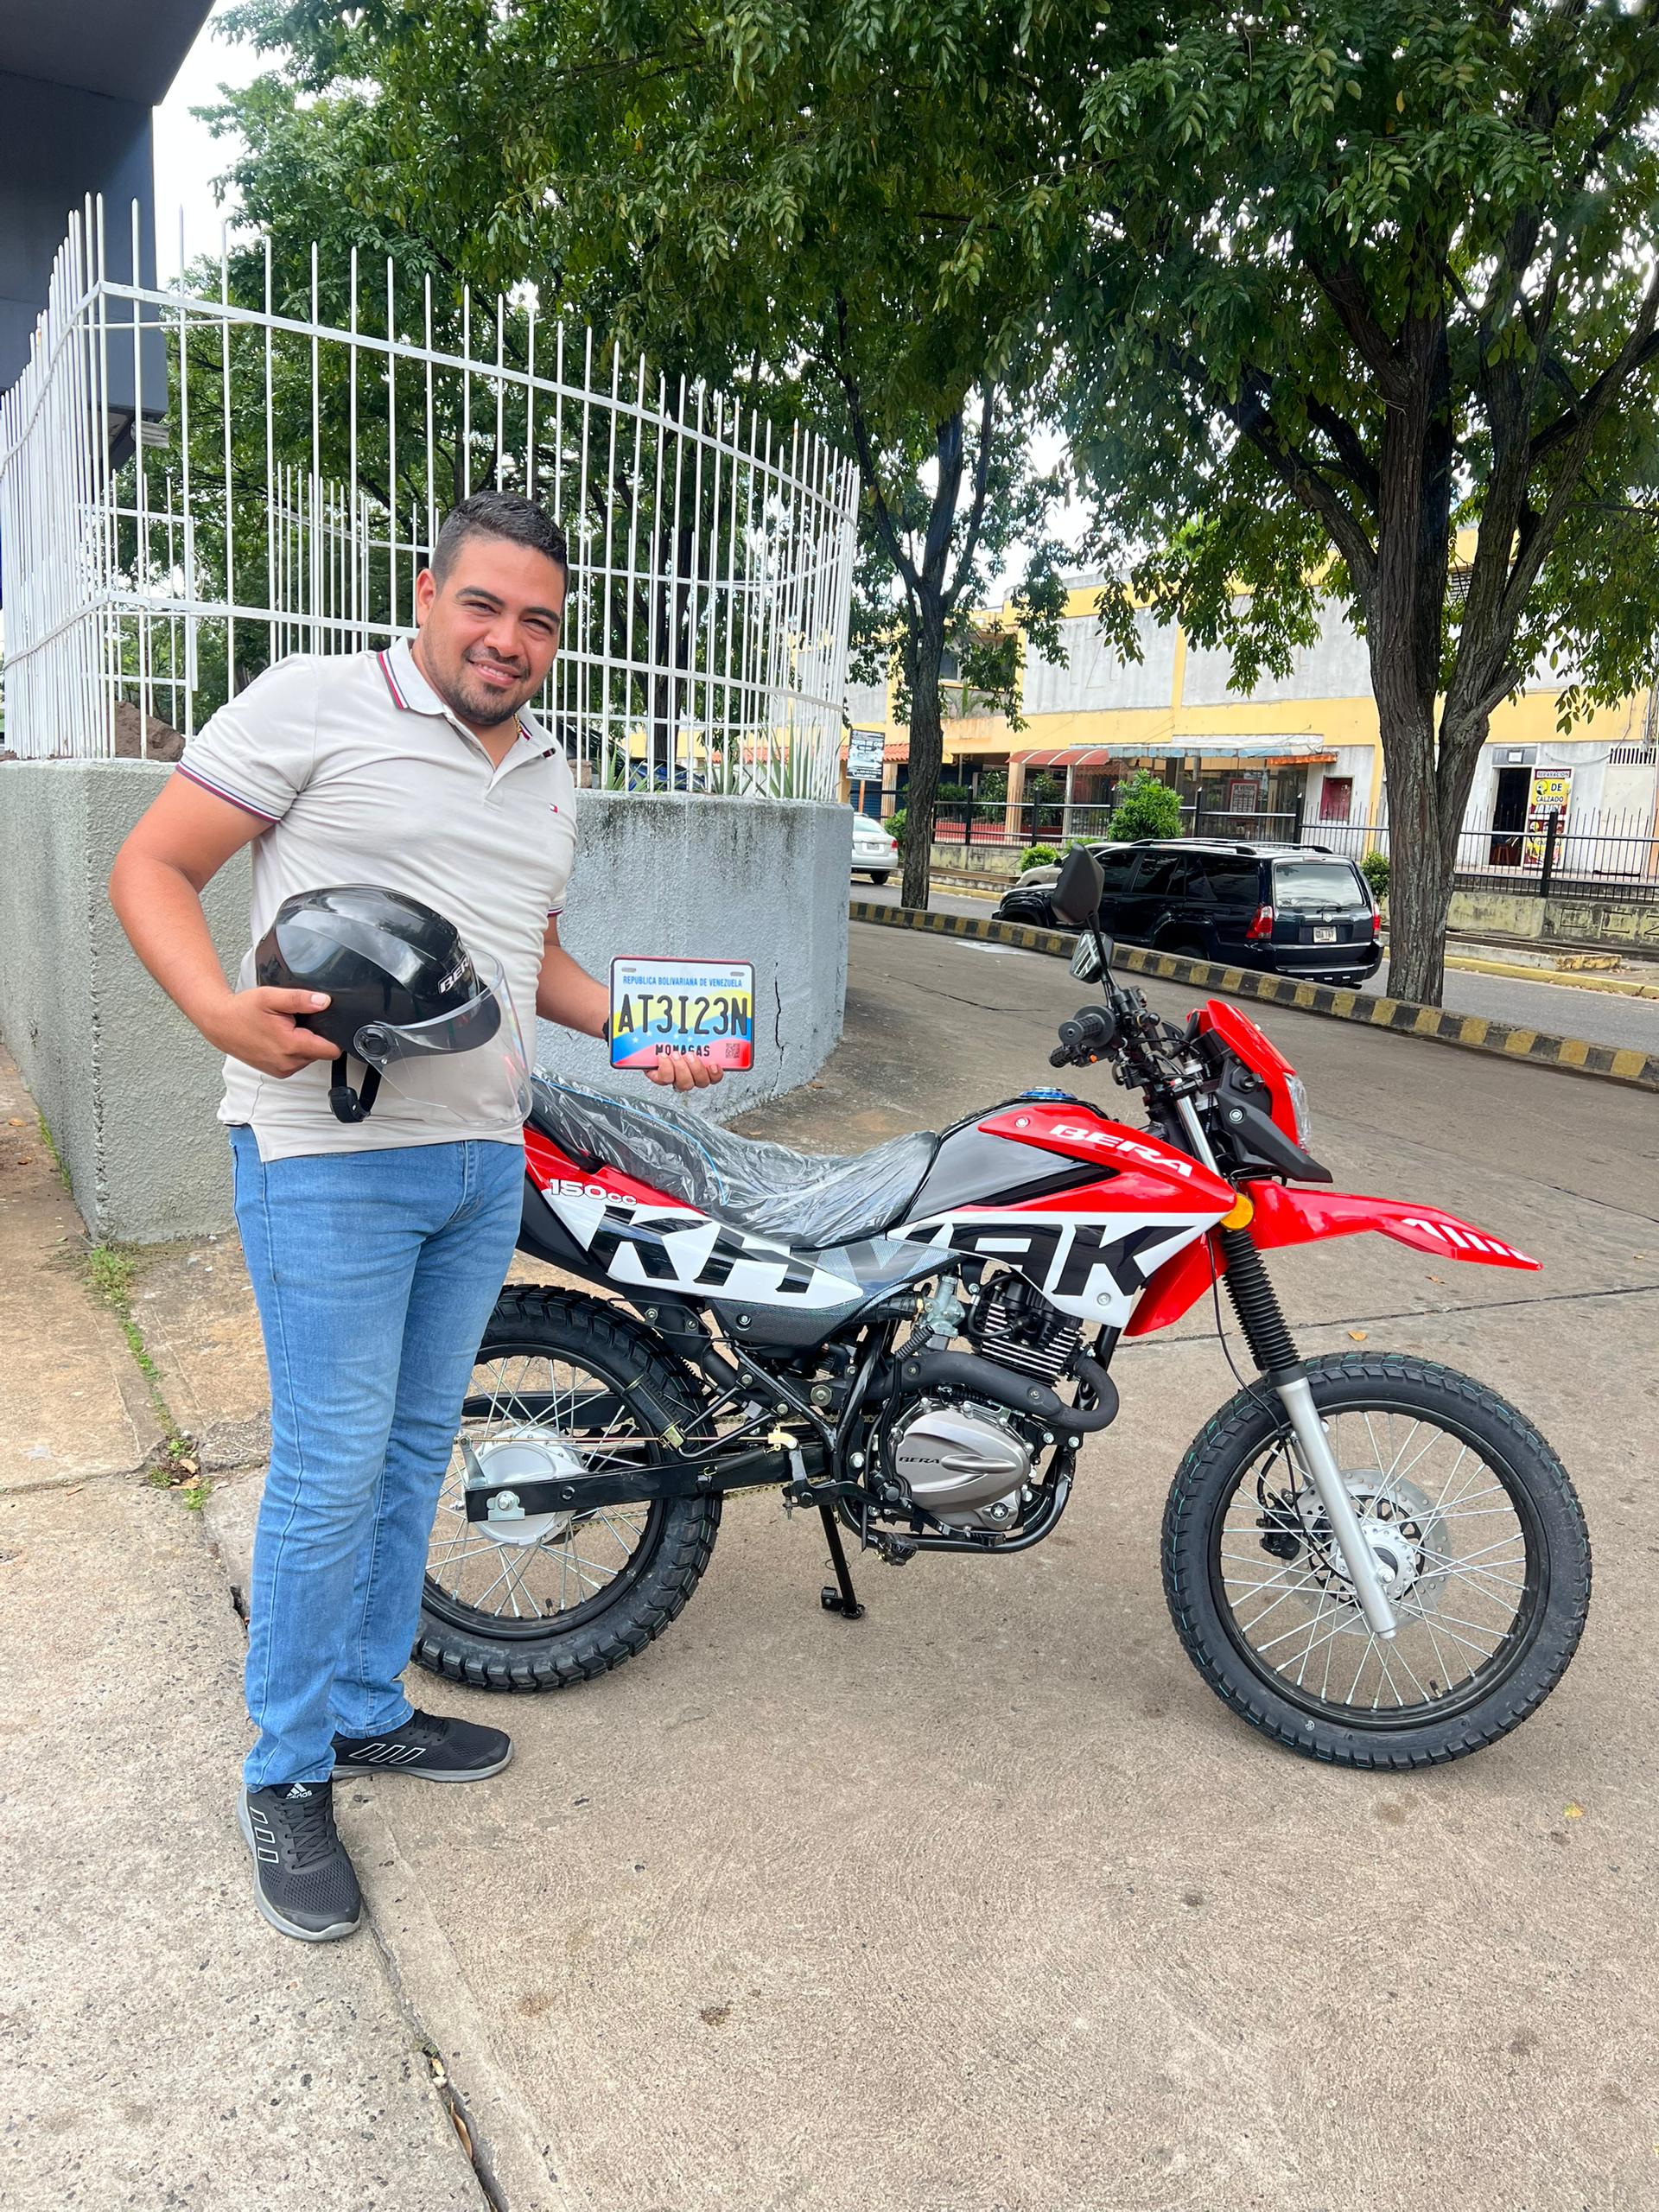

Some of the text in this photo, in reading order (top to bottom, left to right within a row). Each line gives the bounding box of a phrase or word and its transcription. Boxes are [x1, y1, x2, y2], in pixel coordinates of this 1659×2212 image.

[1551, 783, 1562, 791] DE
[440, 956, 469, 994] BER
[623, 976, 742, 988] REPUBLICA BOLIVARIANA DE VENEZUELA
[1050, 1124, 1193, 1178] BERA
[550, 1178, 638, 1206] 150cc
[899, 1456, 940, 1465] BERA
[286, 1789, 312, 1799] didas
